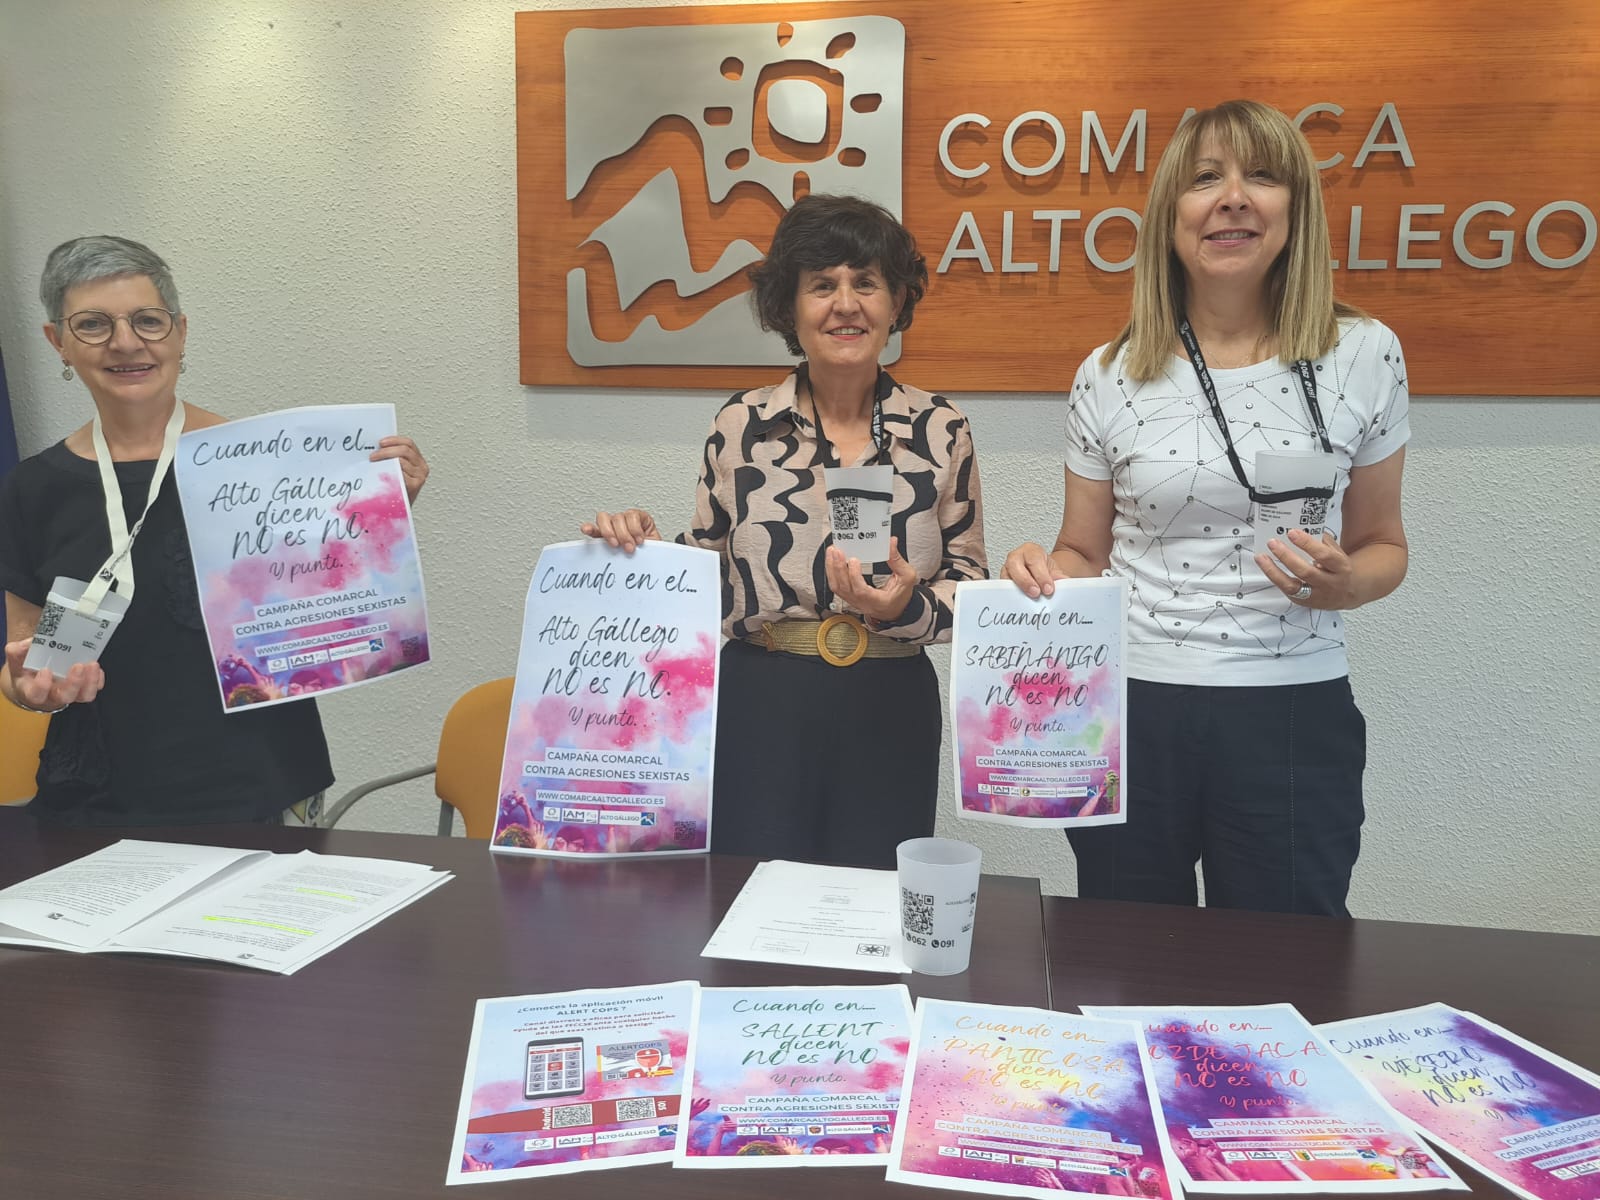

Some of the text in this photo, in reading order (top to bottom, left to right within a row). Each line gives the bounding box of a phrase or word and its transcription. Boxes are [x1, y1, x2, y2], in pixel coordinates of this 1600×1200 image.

[938, 102, 1416, 178] COMCA
[936, 207, 1143, 273] ALTO
[193, 429, 292, 466] Cuando
[303, 436, 336, 452] en
[208, 477, 362, 512] Alto Gállego
[256, 500, 327, 528] dicen
[284, 528, 306, 547] es
[866, 532, 877, 540] 091
[290, 554, 344, 583] punto.
[540, 562, 616, 595] Cuando
[625, 571, 660, 591] en
[256, 588, 379, 618] CAMPAÑA COMARCAL
[236, 595, 407, 637] CONTRA AGRESIONES SEXISTAS
[977, 606, 1051, 630] Cuando
[538, 615, 679, 662] Alto Gállego
[56, 643, 72, 653] 091
[569, 640, 634, 669] dicen
[965, 641, 1110, 670] SABIÑÁNIGO
[589, 676, 610, 694] es
[1013, 664, 1067, 690] dicen
[1026, 690, 1044, 706] es
[584, 707, 637, 732] punto.
[1024, 718, 1066, 737] punto.
[547, 750, 664, 766] CAMPAÑA COMARCAL
[995, 748, 1087, 758] CAMPAÑA COMARCAL
[977, 758, 1108, 768] CONTRA AGRESIONES SEXISTAS
[525, 764, 690, 782] CONTRA AGRESIONES SEXISTAS
[563, 810, 585, 819] IAM
[911, 935, 954, 948] 062 091
[635, 995, 664, 1003] móvil
[732, 999, 824, 1014] Cuando
[556, 1008, 588, 1016] ALERT
[741, 1021, 884, 1038] SALLENT
[955, 1015, 1052, 1038] Cuando
[1146, 1019, 1219, 1036] uando
[779, 1035, 850, 1052] dicen
[1328, 1028, 1411, 1054] Cuando
[797, 1053, 820, 1064] es
[943, 1037, 1129, 1075] PANTICOSA
[1233, 1040, 1327, 1060] JACA
[997, 1058, 1069, 1079] dicen
[1196, 1057, 1264, 1074] dicen
[790, 1073, 846, 1087] punto.
[1019, 1079, 1044, 1090] es
[1227, 1075, 1251, 1087] es
[1432, 1067, 1492, 1087] dicen
[1469, 1083, 1494, 1097] es
[748, 1094, 881, 1104] CAMPAÑA COMARCAL
[720, 1105, 772, 1113] CONTRA
[774, 1104, 853, 1112] AGRESIONES
[1192, 1126, 1385, 1137] CONTRA AGRESIONES SEXISTAS
[1213, 1118, 1347, 1128] CAMPAÑA COMARCAL
[937, 1122, 990, 1135] CONTRA
[992, 1128, 1074, 1145] AGRESIONES
[1034, 1125, 1107, 1139] COMARCAL
[1506, 1129, 1556, 1145] CAMPAÑA
[1500, 1145, 1543, 1159] CONTRA
